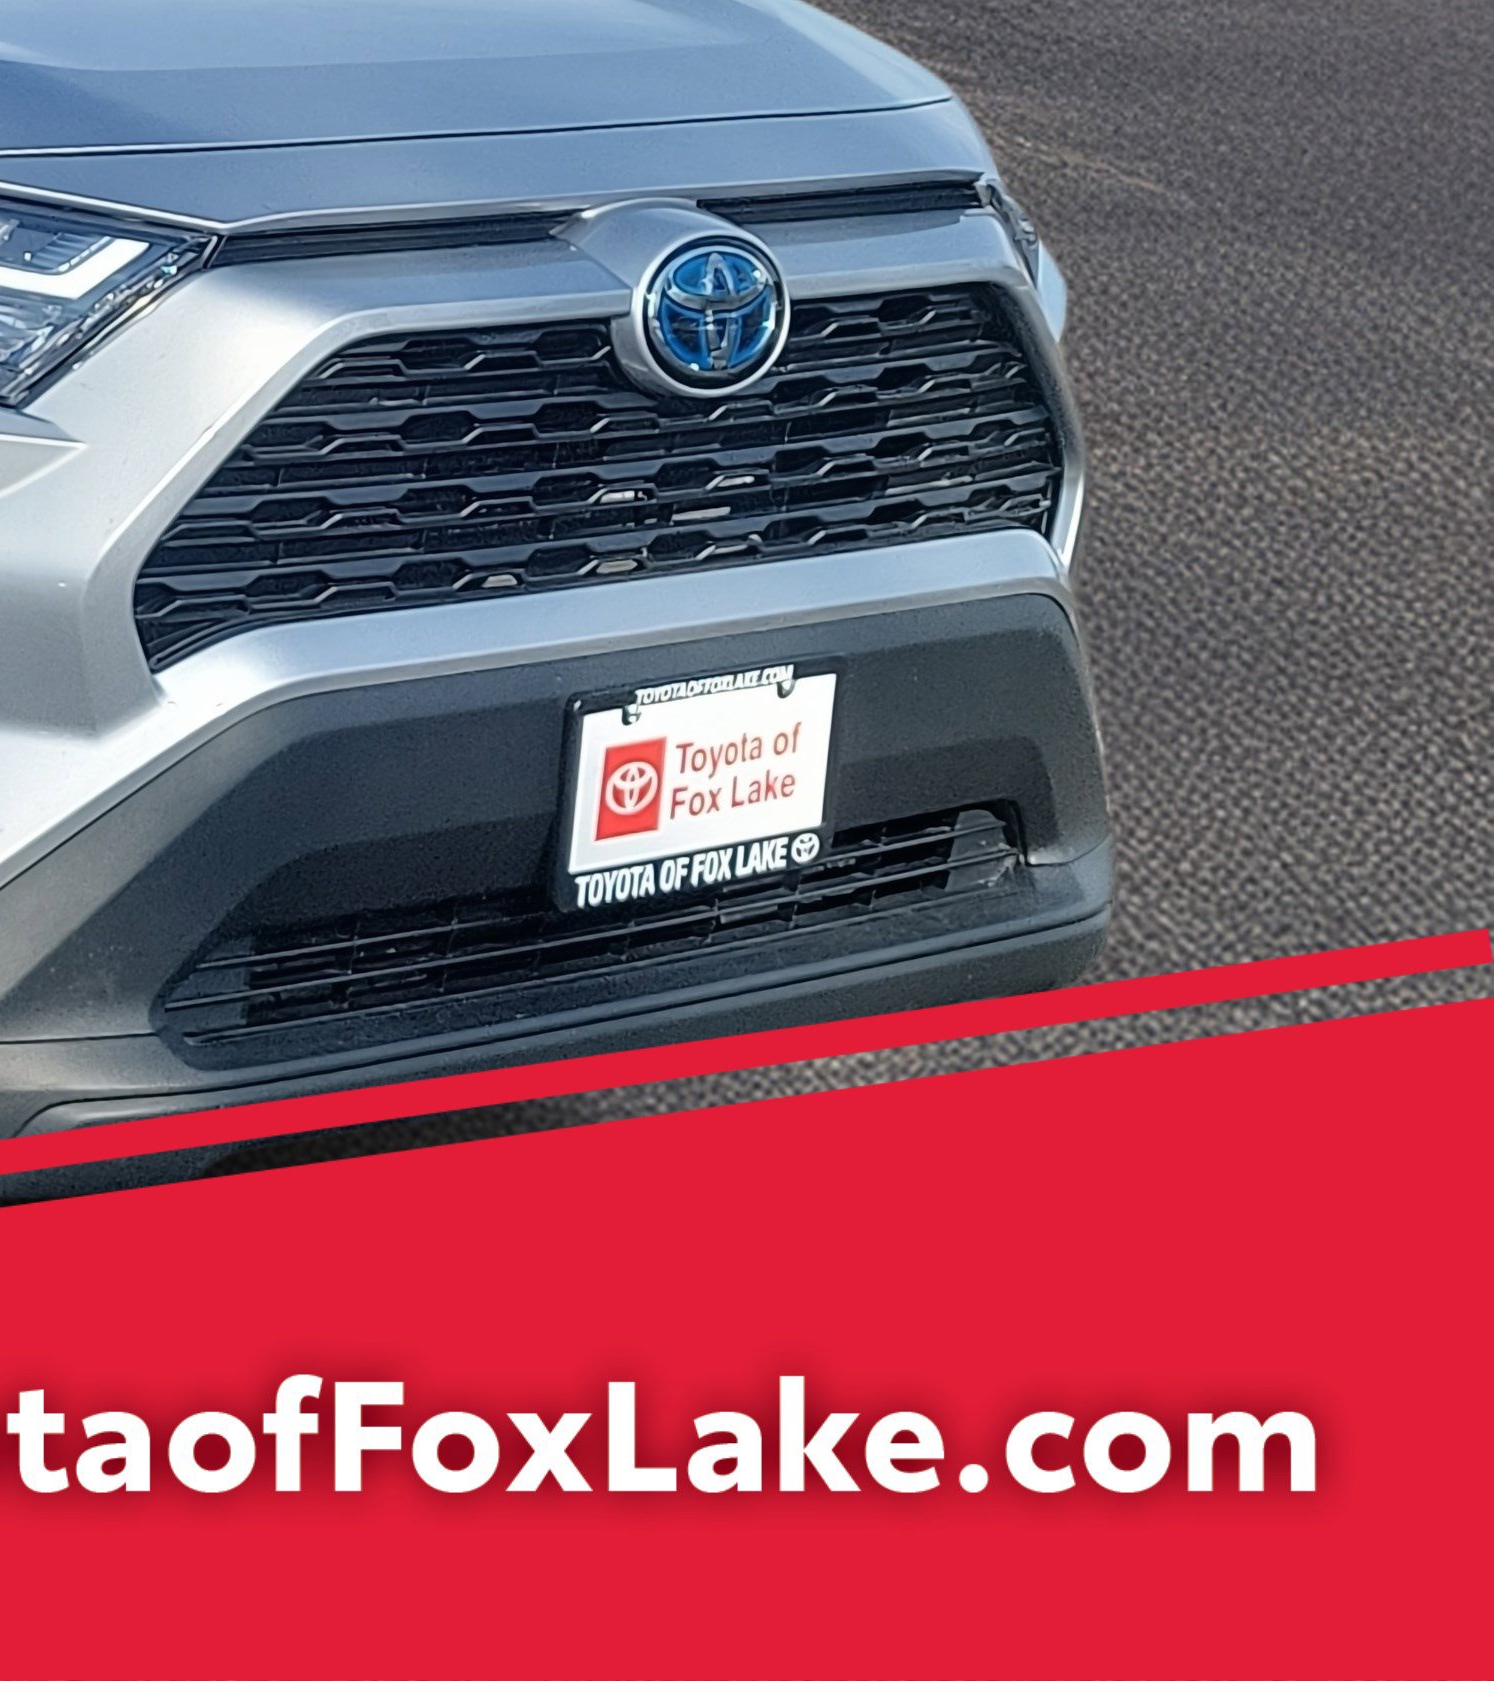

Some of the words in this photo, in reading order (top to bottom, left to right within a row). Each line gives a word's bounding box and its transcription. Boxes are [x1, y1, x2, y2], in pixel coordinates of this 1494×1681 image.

[675, 731, 763, 779] Toyota
[773, 721, 802, 756] of
[668, 785, 721, 820] Fox
[730, 769, 796, 809] Lake
[574, 864, 655, 908] TOYOTA
[659, 857, 692, 894] OF
[690, 846, 733, 887] FOX
[735, 836, 790, 878] LAKE
